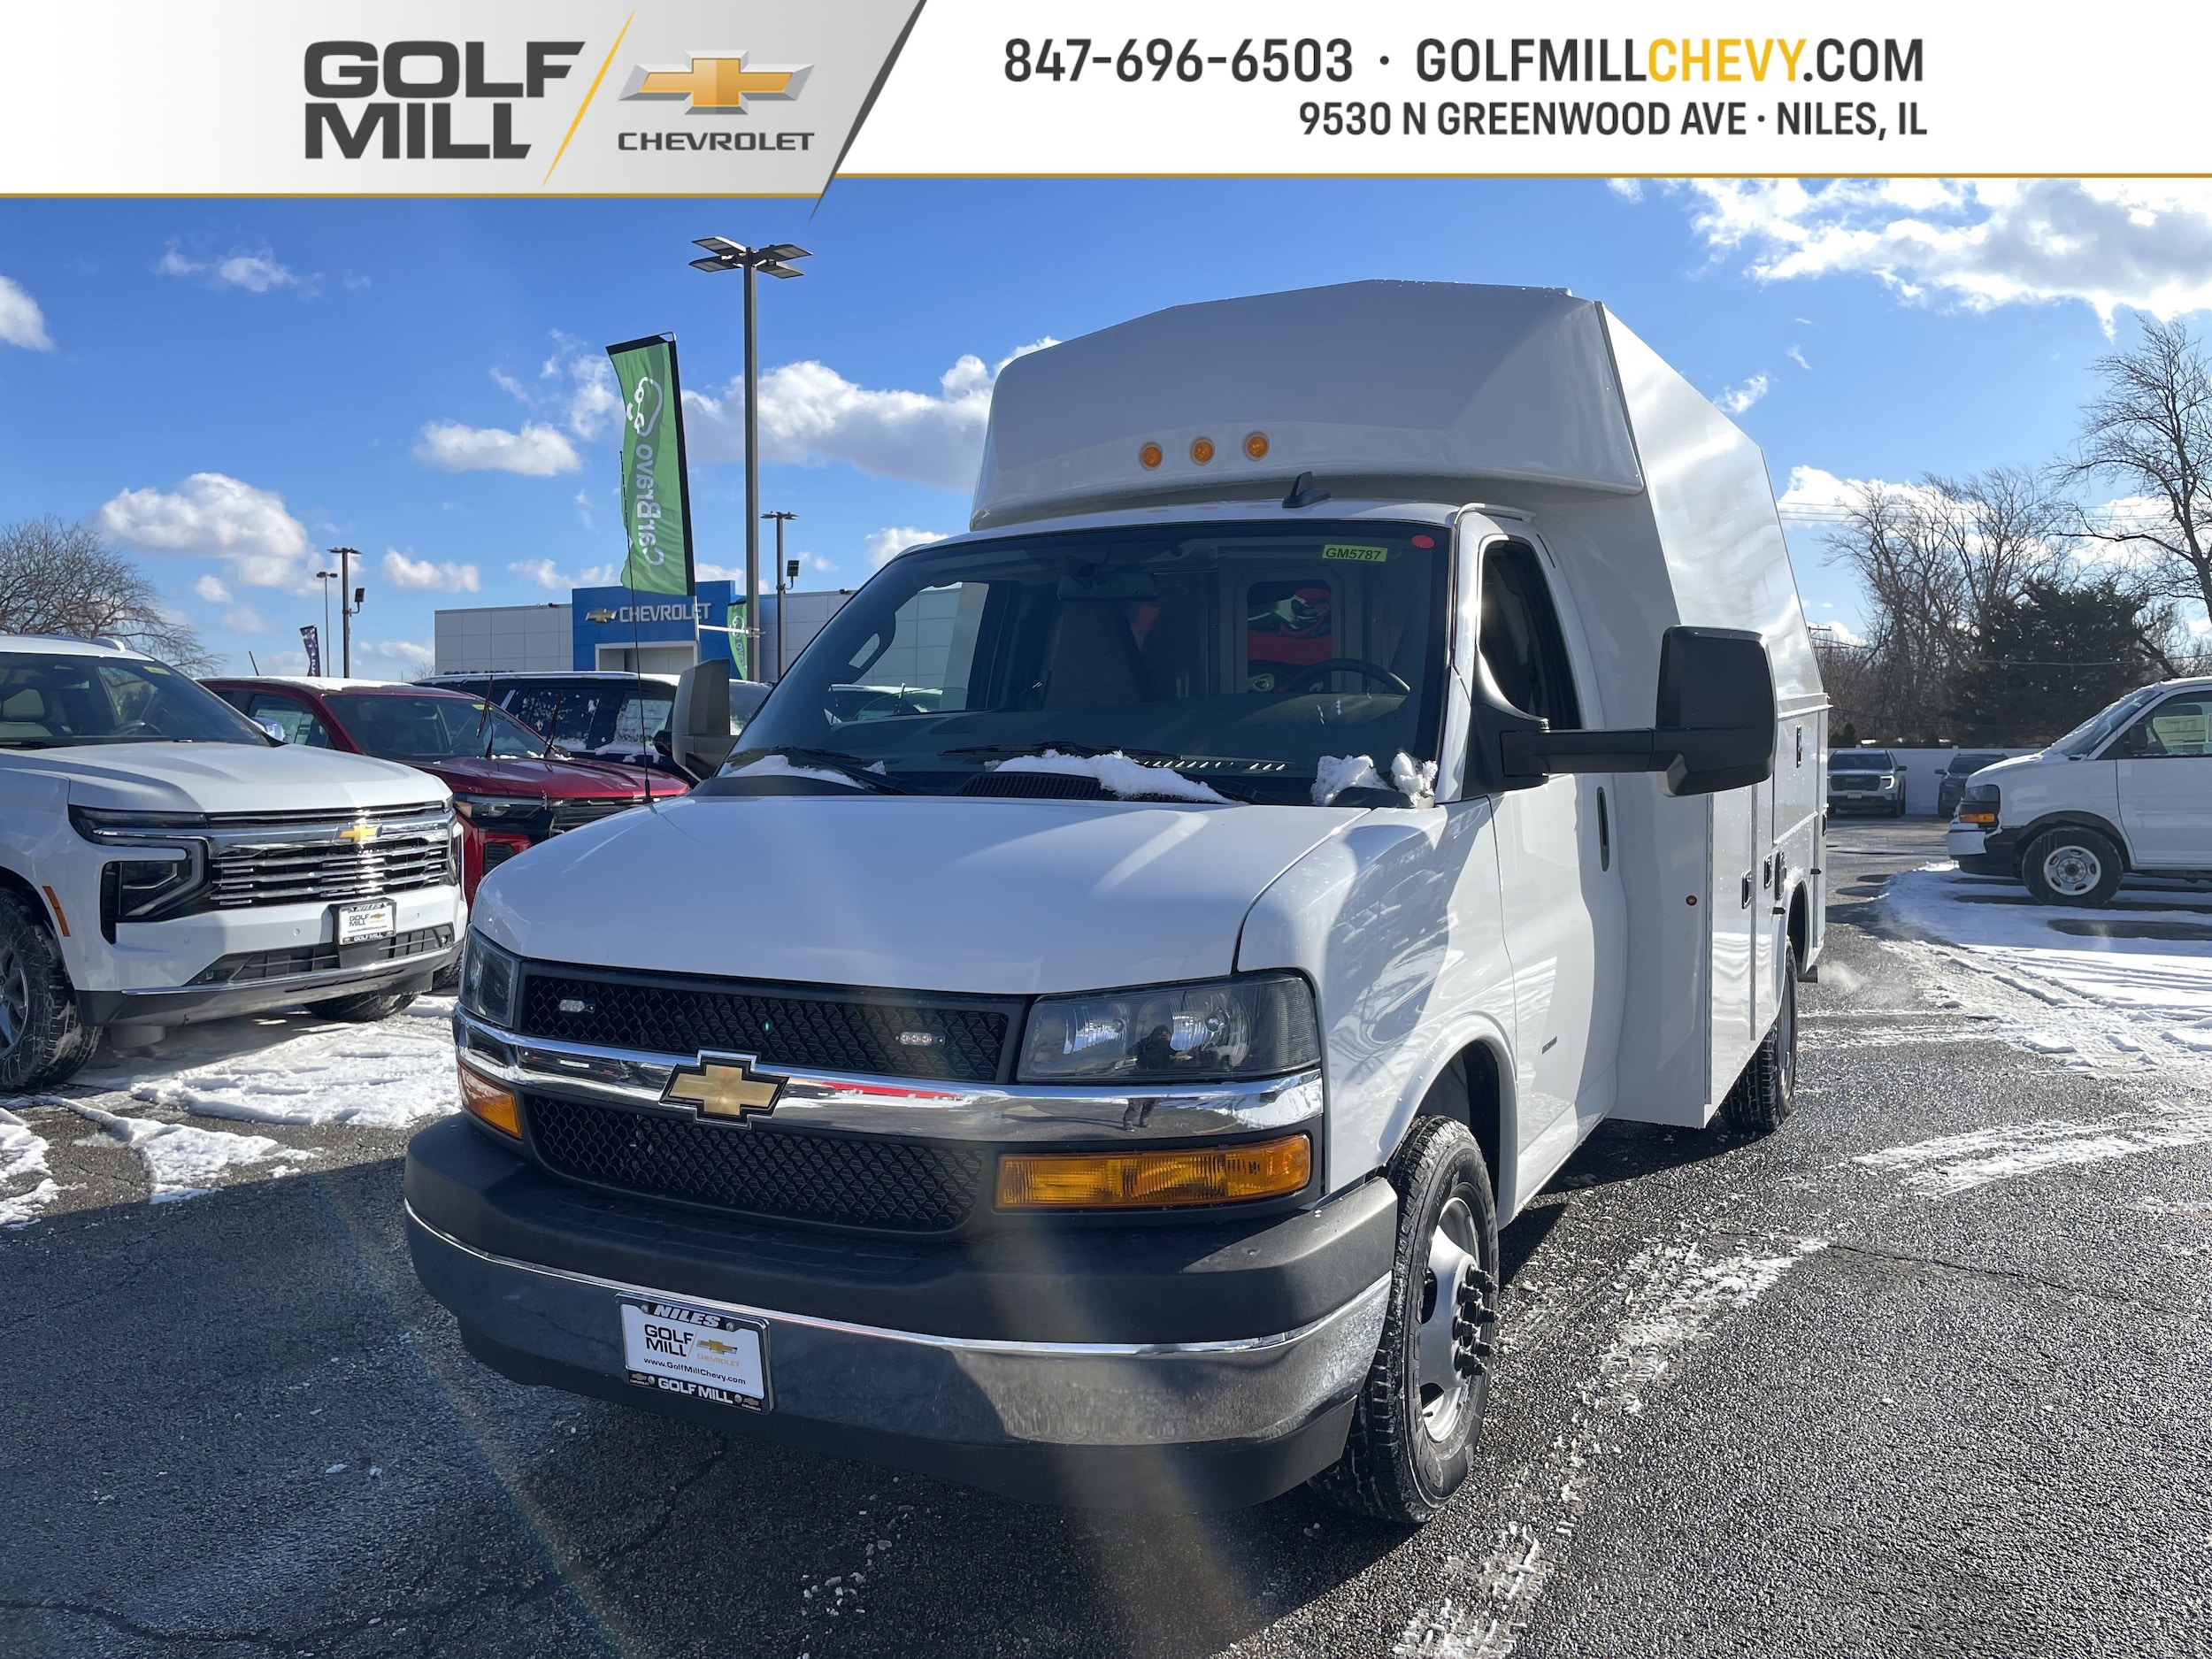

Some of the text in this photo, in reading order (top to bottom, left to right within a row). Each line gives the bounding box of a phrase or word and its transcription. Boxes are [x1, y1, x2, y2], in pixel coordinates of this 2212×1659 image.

[1325, 548, 1382, 560] GM5787
[620, 603, 711, 623] CHEVROLET
[653, 1305, 721, 1328] NILES
[644, 1324, 695, 1344] GOLF
[646, 1337, 687, 1357] MILL
[696, 1353, 740, 1367] CHEVROLET
[643, 1356, 746, 1385] www.GolfMillChevy.com
[658, 1377, 733, 1404] GOLF MILL
